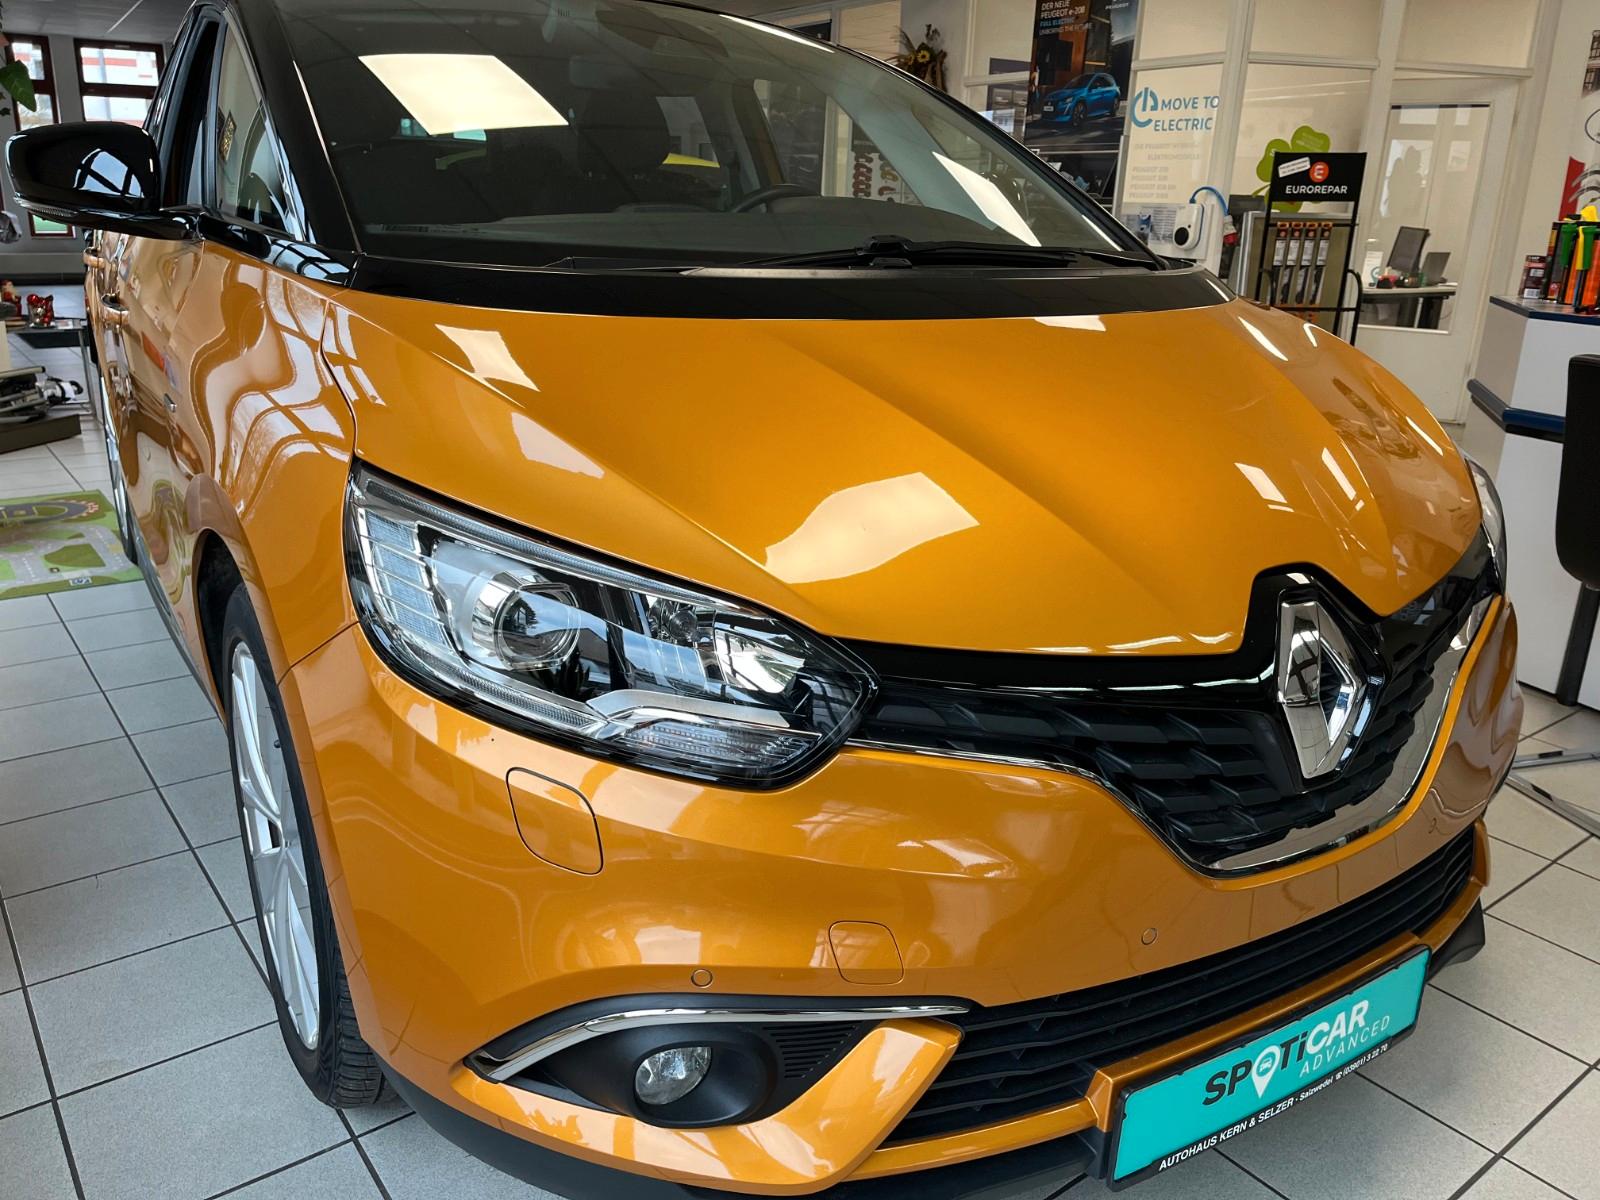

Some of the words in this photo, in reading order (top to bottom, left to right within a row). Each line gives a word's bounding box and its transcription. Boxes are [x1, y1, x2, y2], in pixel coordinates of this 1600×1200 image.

[1041, 2, 1054, 11] DER
[1054, 0, 1070, 8] NEUE
[1040, 9, 1068, 19] PEUGEOT
[1160, 97, 1199, 111] MOVE
[1203, 95, 1220, 109] TO
[1153, 117, 1213, 132] ELECTRIC
[1285, 185, 1348, 195] EUROREPAR
[1299, 1015, 1391, 1078] ADVANCED
[1158, 1135, 1218, 1171] AUTOHAUS
[1219, 1120, 1248, 1142] KERN
[1248, 1117, 1256, 1128] &
[1257, 1096, 1294, 1123] SELZER
[1299, 1075, 1334, 1101] Salzwedel
